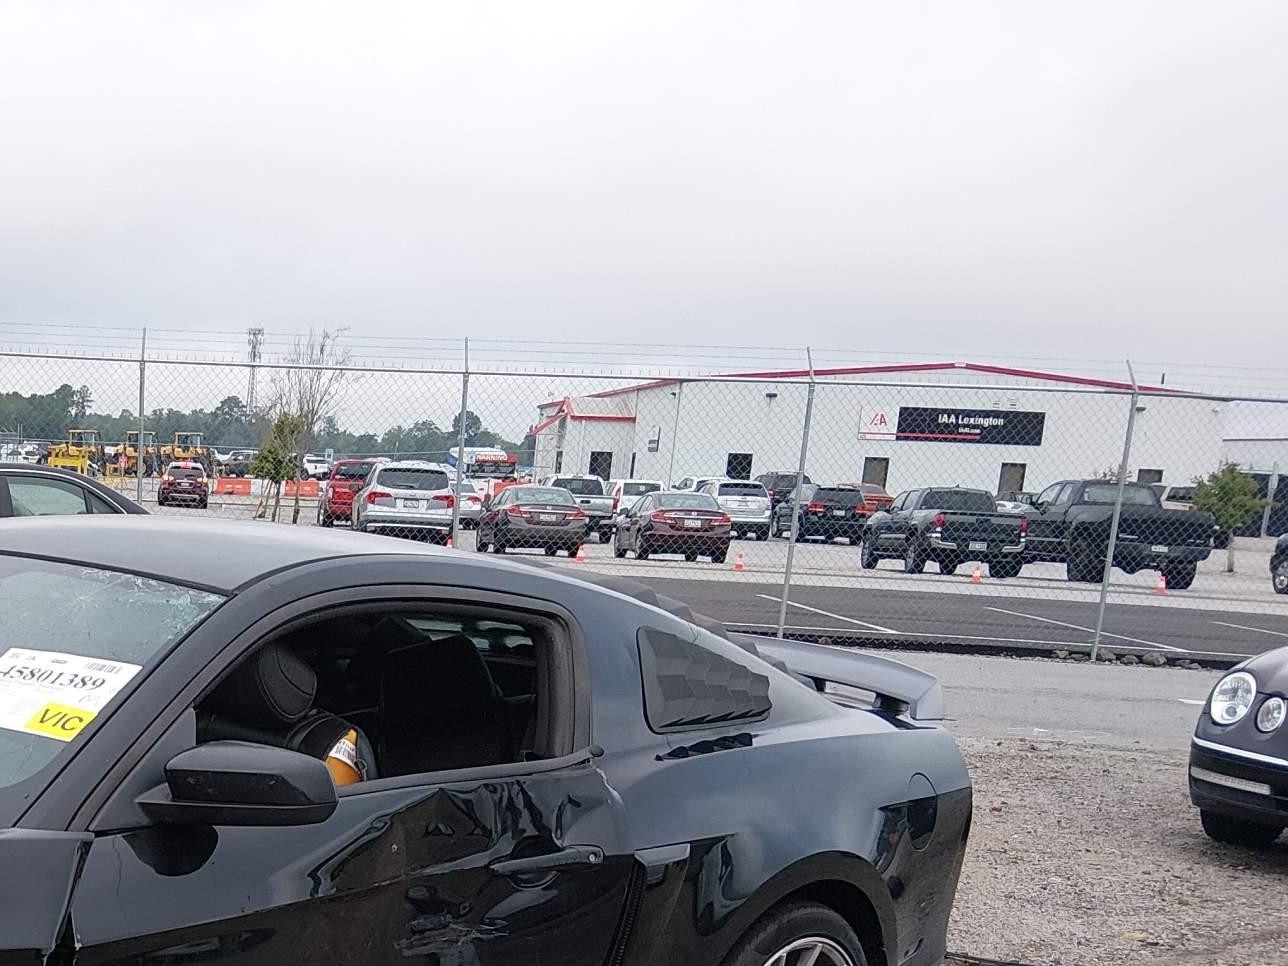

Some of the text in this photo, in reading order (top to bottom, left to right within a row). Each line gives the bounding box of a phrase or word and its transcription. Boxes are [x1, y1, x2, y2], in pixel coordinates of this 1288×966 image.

[938, 413, 1004, 427] IAA Lexington
[0, 664, 107, 692] 45801389
[38, 707, 85, 731] VIC
